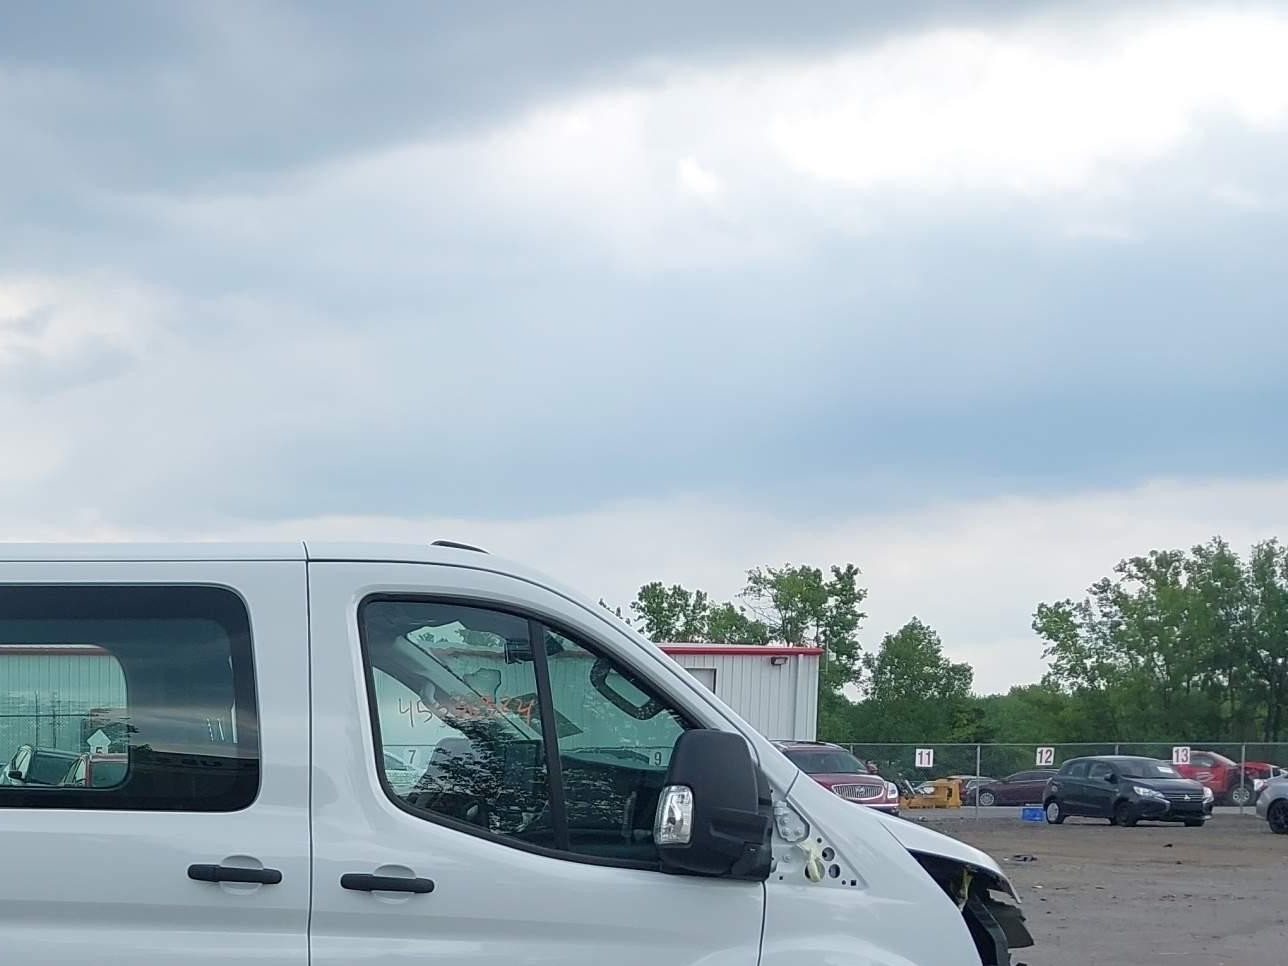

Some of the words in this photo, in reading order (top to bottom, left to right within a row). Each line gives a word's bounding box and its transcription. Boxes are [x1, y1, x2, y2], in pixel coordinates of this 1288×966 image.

[407, 749, 416, 765] 7
[654, 751, 662, 766] 9
[918, 751, 931, 765] 11
[1037, 749, 1053, 764] 12
[1174, 748, 1189, 763] 13
